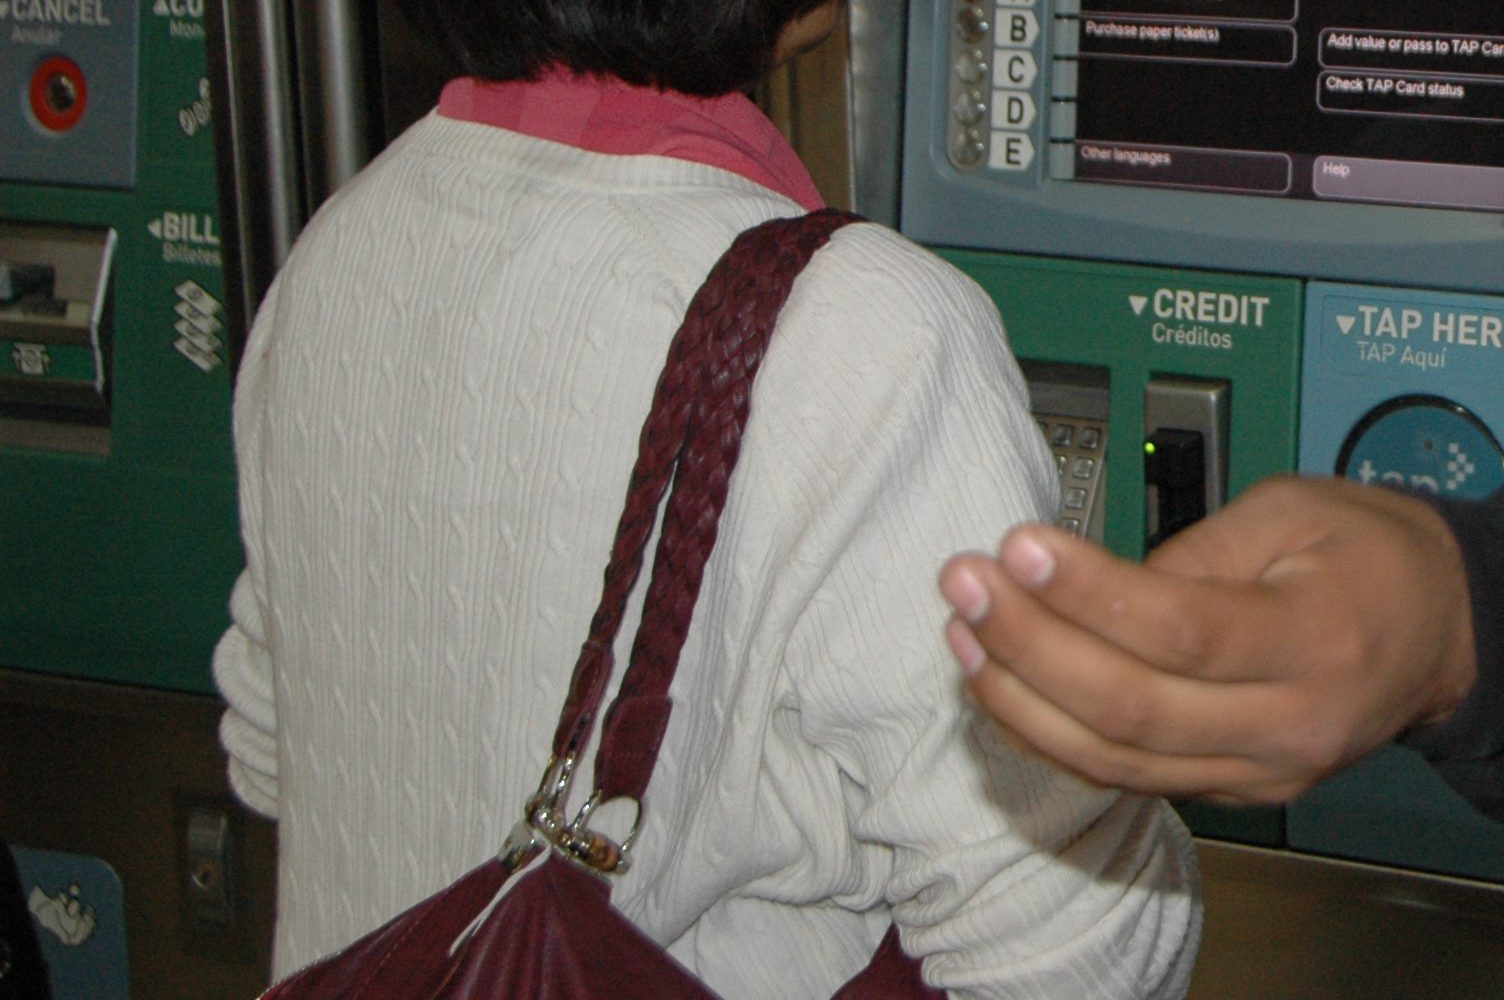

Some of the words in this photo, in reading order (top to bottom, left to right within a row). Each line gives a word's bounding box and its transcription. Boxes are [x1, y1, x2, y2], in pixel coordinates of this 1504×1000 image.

[1009, 13, 1027, 43] B
[1085, 20, 1138, 37] Purchase
[1139, 25, 1172, 42] paper
[1327, 33, 1353, 50] Add
[1354, 34, 1386, 52] value
[1388, 38, 1401, 51] or
[1403, 38, 1433, 55] pass
[1435, 39, 1448, 54] to
[1452, 39, 1479, 56] TAP
[1007, 55, 1026, 83] C
[1326, 75, 1364, 92] Check
[1367, 77, 1393, 92] TAP
[1396, 79, 1426, 96] Card
[1428, 83, 1465, 100] status
[1006, 96, 1025, 124] D
[1005, 137, 1021, 166] E
[1081, 145, 1112, 161] Other
[1113, 147, 1171, 168] languages
[1323, 160, 1350, 178] Help
[163, 210, 221, 245] BILL
[1153, 288, 1270, 327] CREDIT
[1152, 322, 1233, 350] Créditos
[1358, 305, 1422, 341] TAP
[1356, 340, 1396, 363] TAP
[1400, 346, 1447, 372] Aquí
